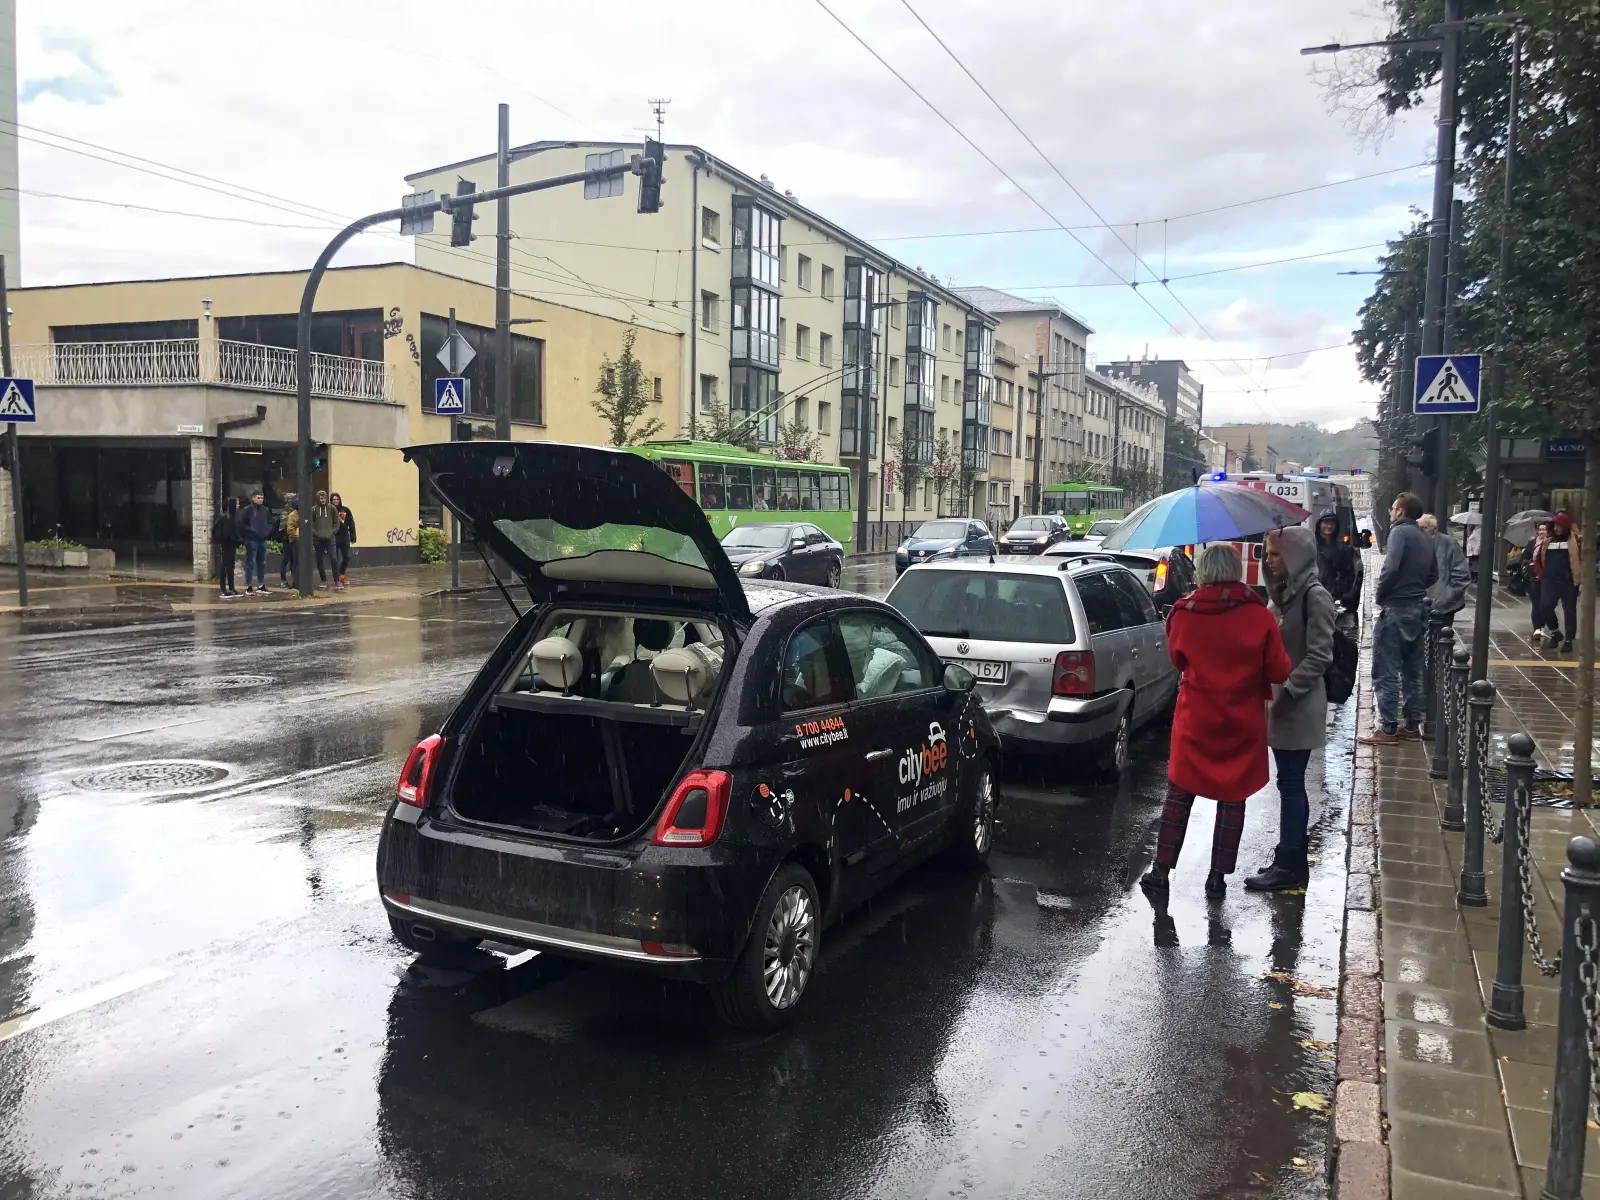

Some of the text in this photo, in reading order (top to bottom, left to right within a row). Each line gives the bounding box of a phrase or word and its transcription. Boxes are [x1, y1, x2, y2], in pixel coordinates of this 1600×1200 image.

[1277, 486, 1298, 496] 033
[976, 663, 1002, 677] 167
[796, 716, 845, 737] 8 700 44844
[899, 742, 947, 787] citybee
[897, 795, 912, 814] imu
[912, 789, 919, 806] ir
